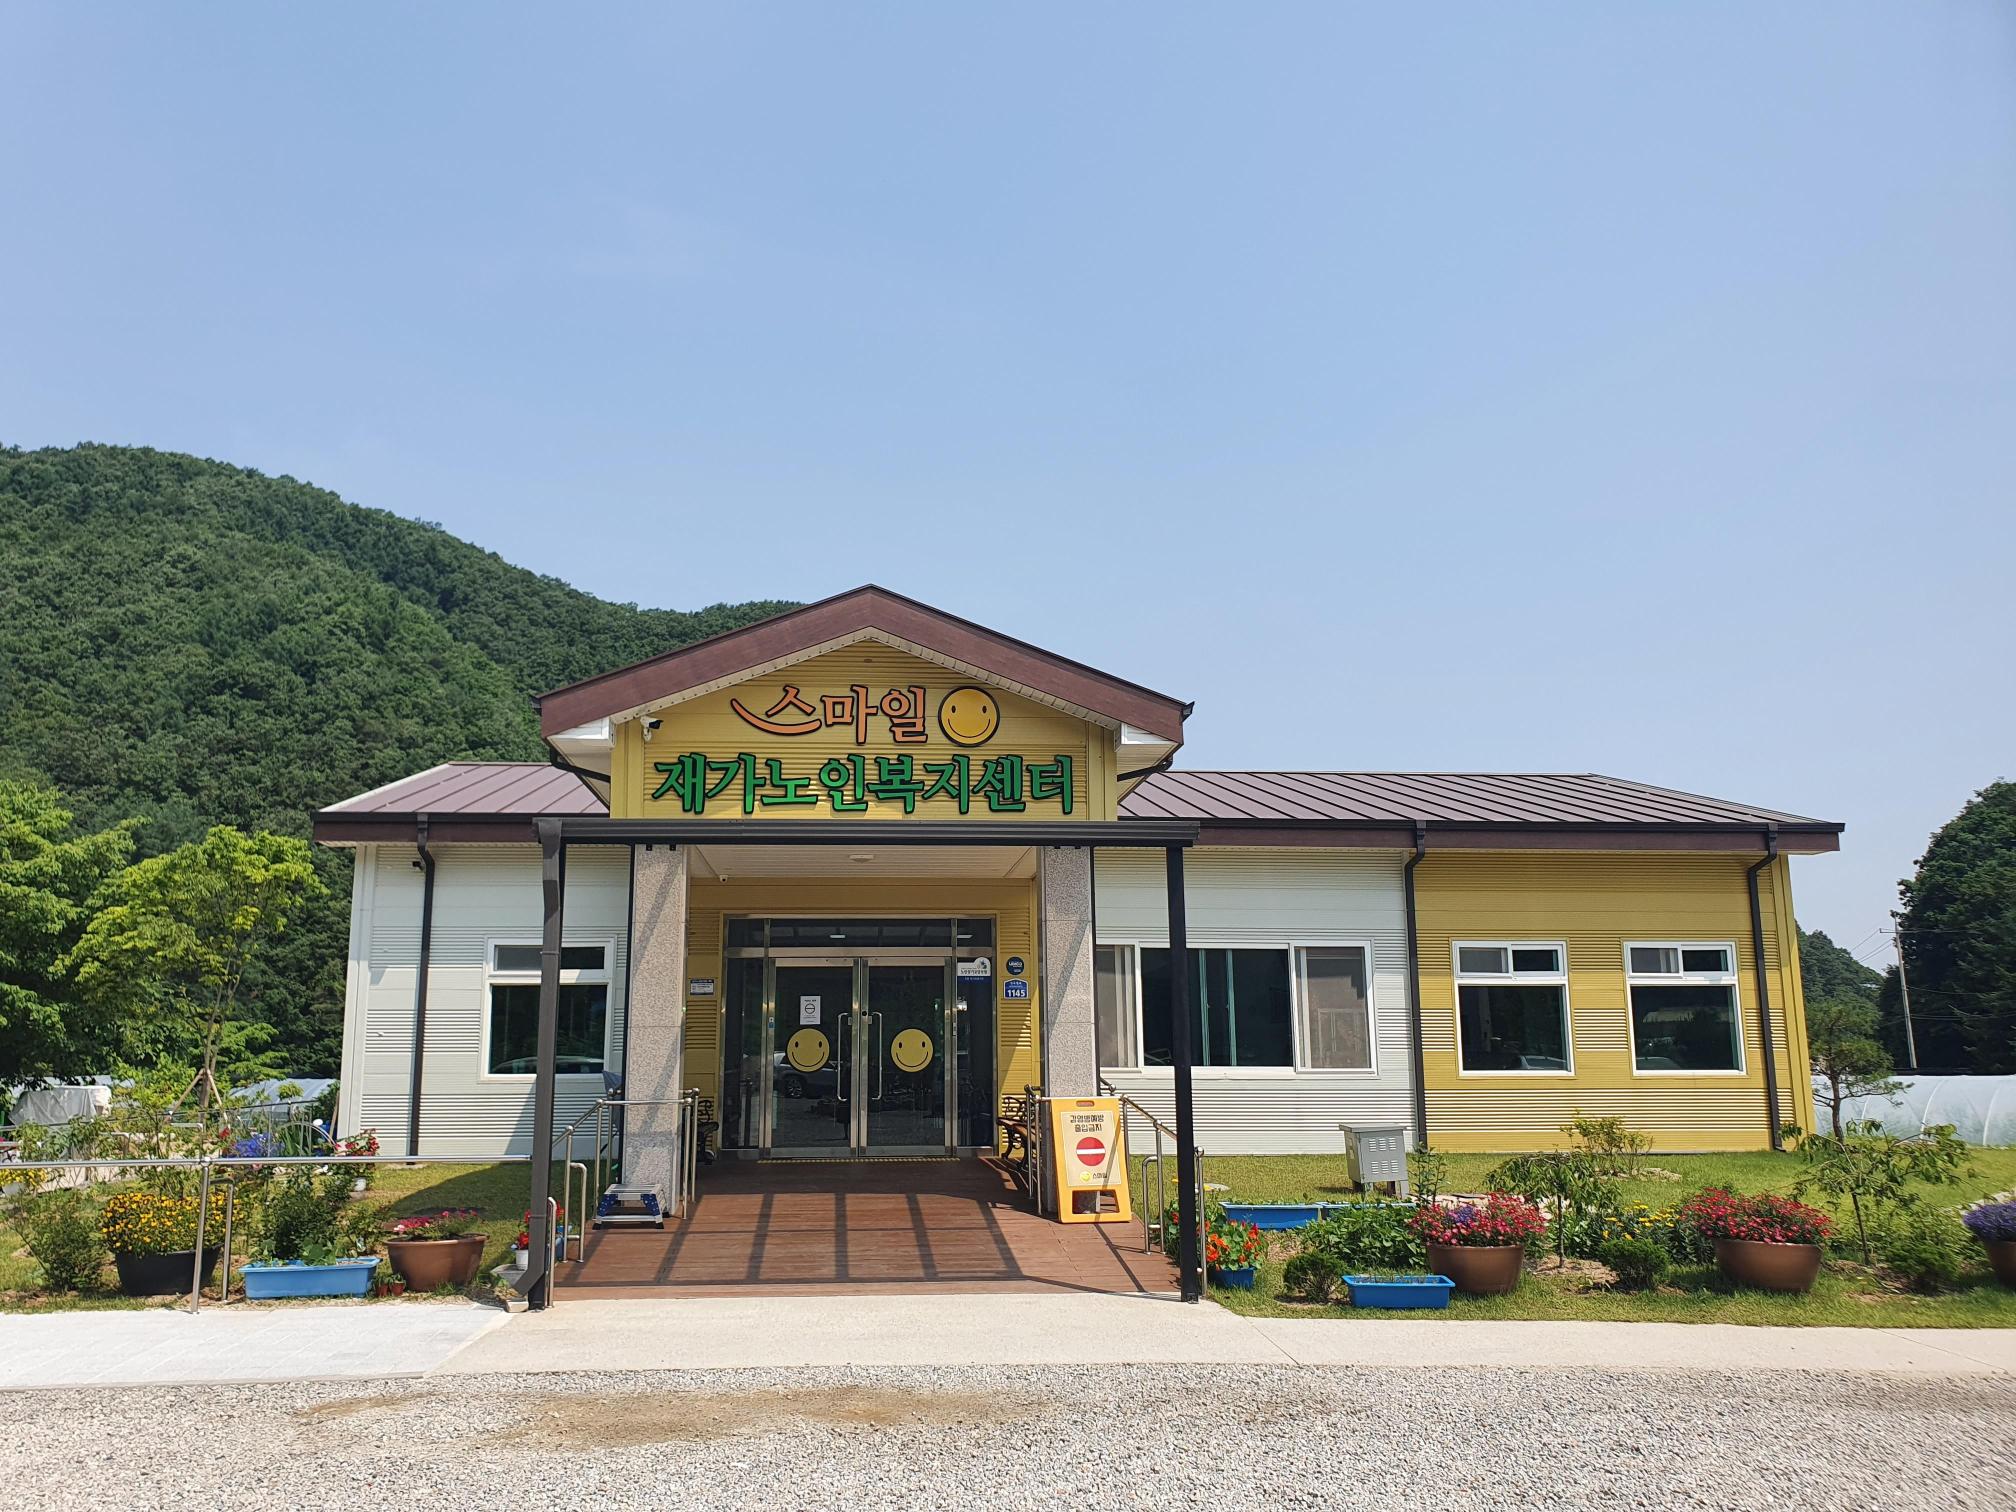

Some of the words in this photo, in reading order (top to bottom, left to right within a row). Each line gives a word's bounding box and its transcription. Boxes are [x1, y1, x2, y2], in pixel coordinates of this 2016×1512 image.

[730, 684, 928, 746] 스마일
[652, 752, 1075, 815] 재가노인복지센터
[1007, 989, 1026, 998] 1145
[1075, 1124, 1102, 1132] 출입금지
